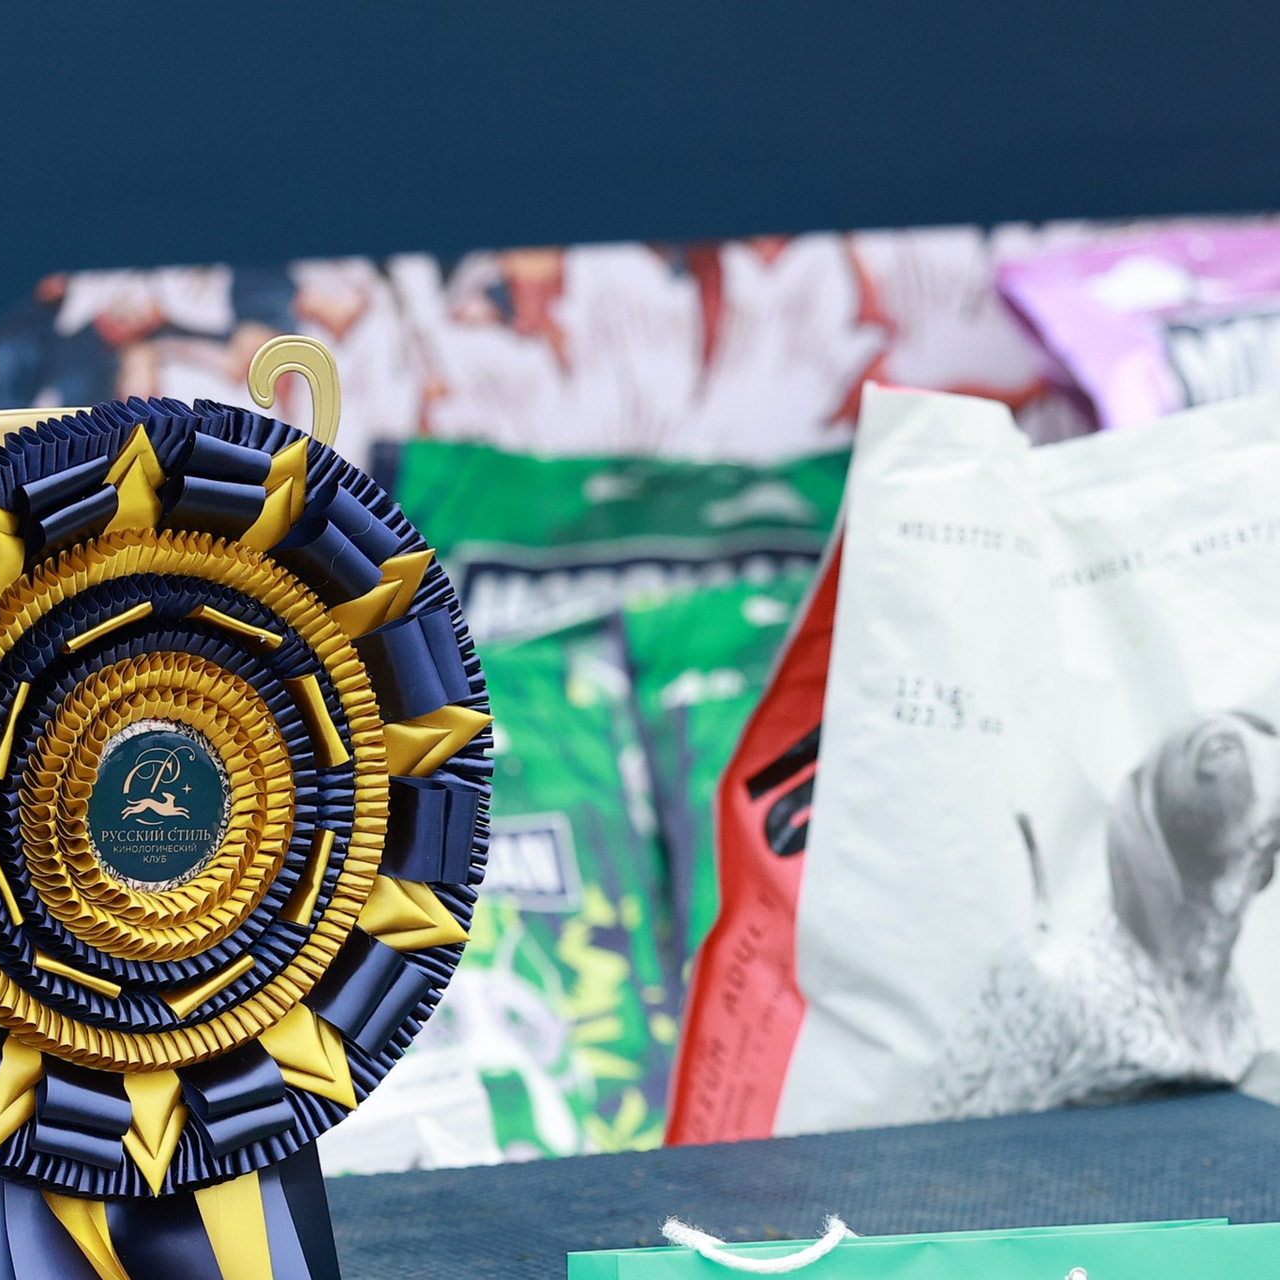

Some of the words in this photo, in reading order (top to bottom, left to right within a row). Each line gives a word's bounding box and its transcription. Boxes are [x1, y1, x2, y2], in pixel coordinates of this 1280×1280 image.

[896, 675, 924, 699] 12
[100, 828, 164, 843] РУССКИЙ
[167, 827, 211, 842] СТИЛЬ
[112, 843, 197, 854] КИНОЛОГИЧЕСКИЙ
[142, 854, 167, 863] КЛУБ
